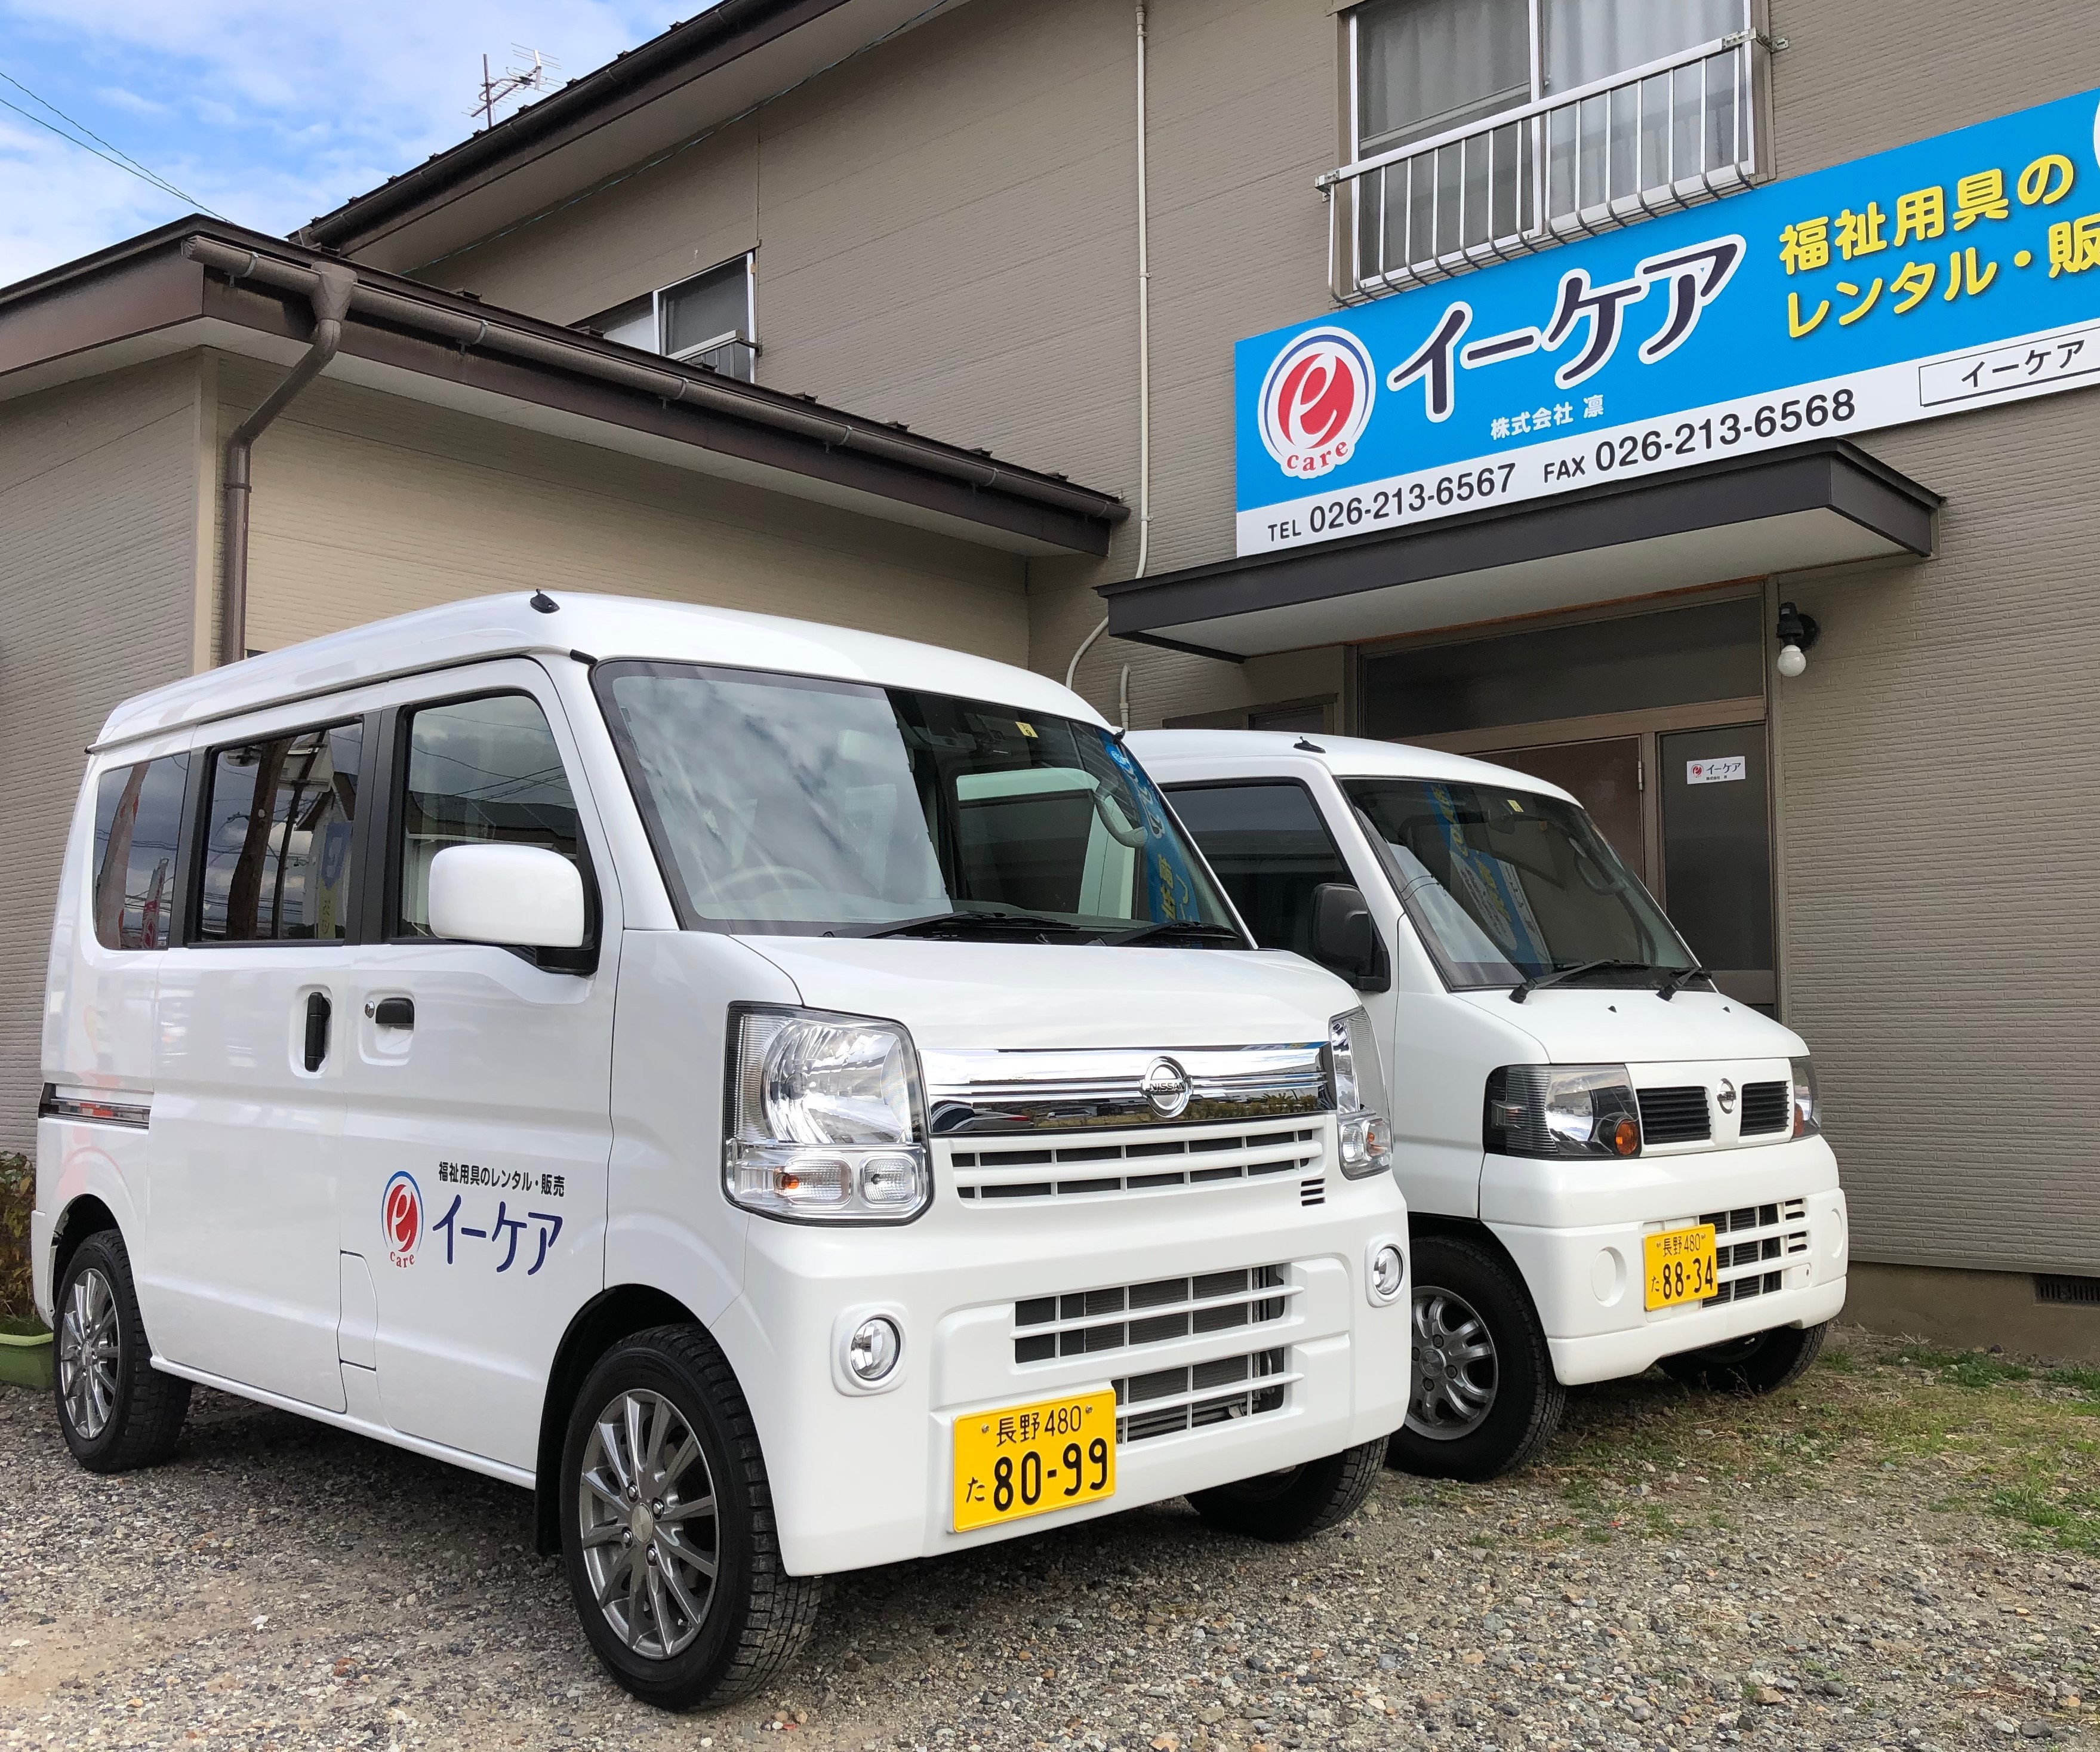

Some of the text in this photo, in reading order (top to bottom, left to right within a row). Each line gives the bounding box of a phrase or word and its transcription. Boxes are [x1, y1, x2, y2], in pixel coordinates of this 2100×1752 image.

[1779, 155, 2074, 275] 福祉用具の
[1390, 238, 1743, 419] イーケア
[1962, 340, 2084, 387] イーケア
[1491, 401, 1574, 441] 株式会社
[1267, 389, 1856, 543] TEL 026-213-6567 FAX 026-213-6568
[1286, 440, 1349, 472] care
[1706, 762, 1741, 775] イーケア
[1149, 1082, 1185, 1092] NISSAN
[438, 1161, 565, 1197] 福祉用具のレンタル・販売
[432, 1194, 564, 1276] イーケア
[390, 1251, 415, 1268] care
[1651, 1255, 1713, 1300] た 88-34
[966, 1437, 1108, 1512] た 80-99
